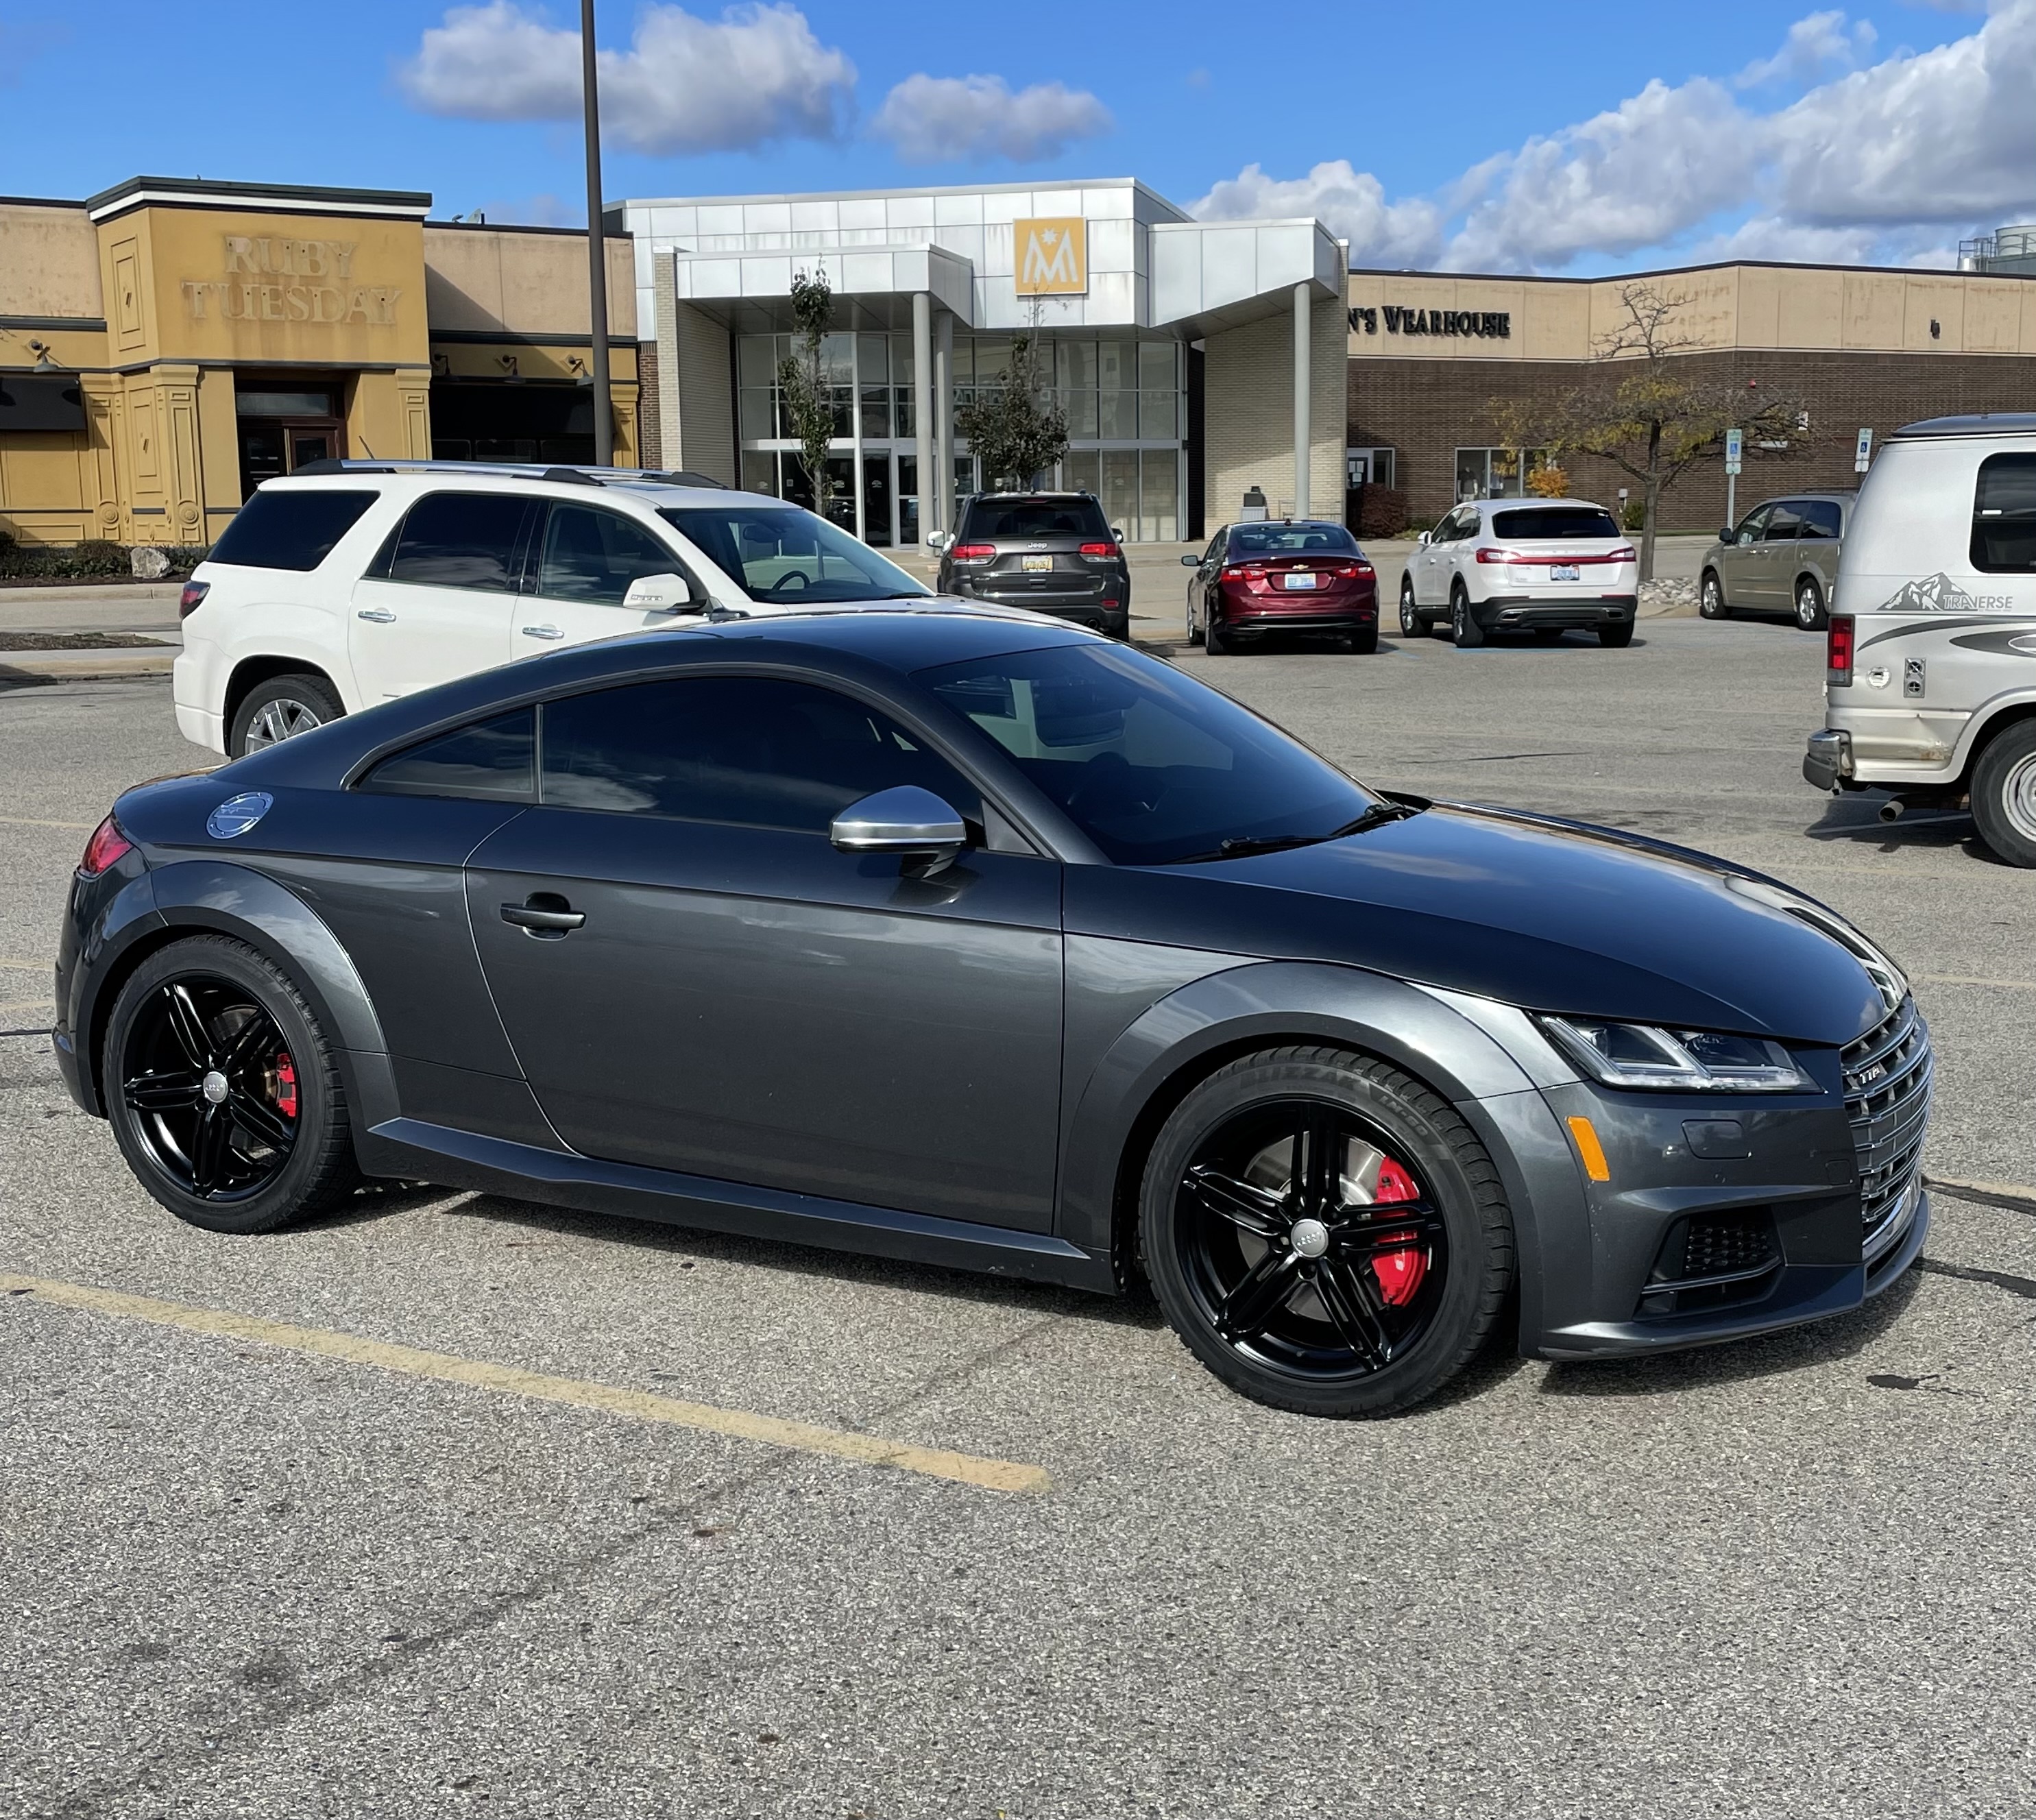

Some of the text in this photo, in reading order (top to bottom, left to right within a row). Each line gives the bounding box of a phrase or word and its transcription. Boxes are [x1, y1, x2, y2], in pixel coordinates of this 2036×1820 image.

[223, 236, 359, 278] RUBY
[181, 281, 403, 324] TUESDAY
[1028, 542, 1047, 550] Jeep
[1943, 594, 2013, 609] TRAVERSE
